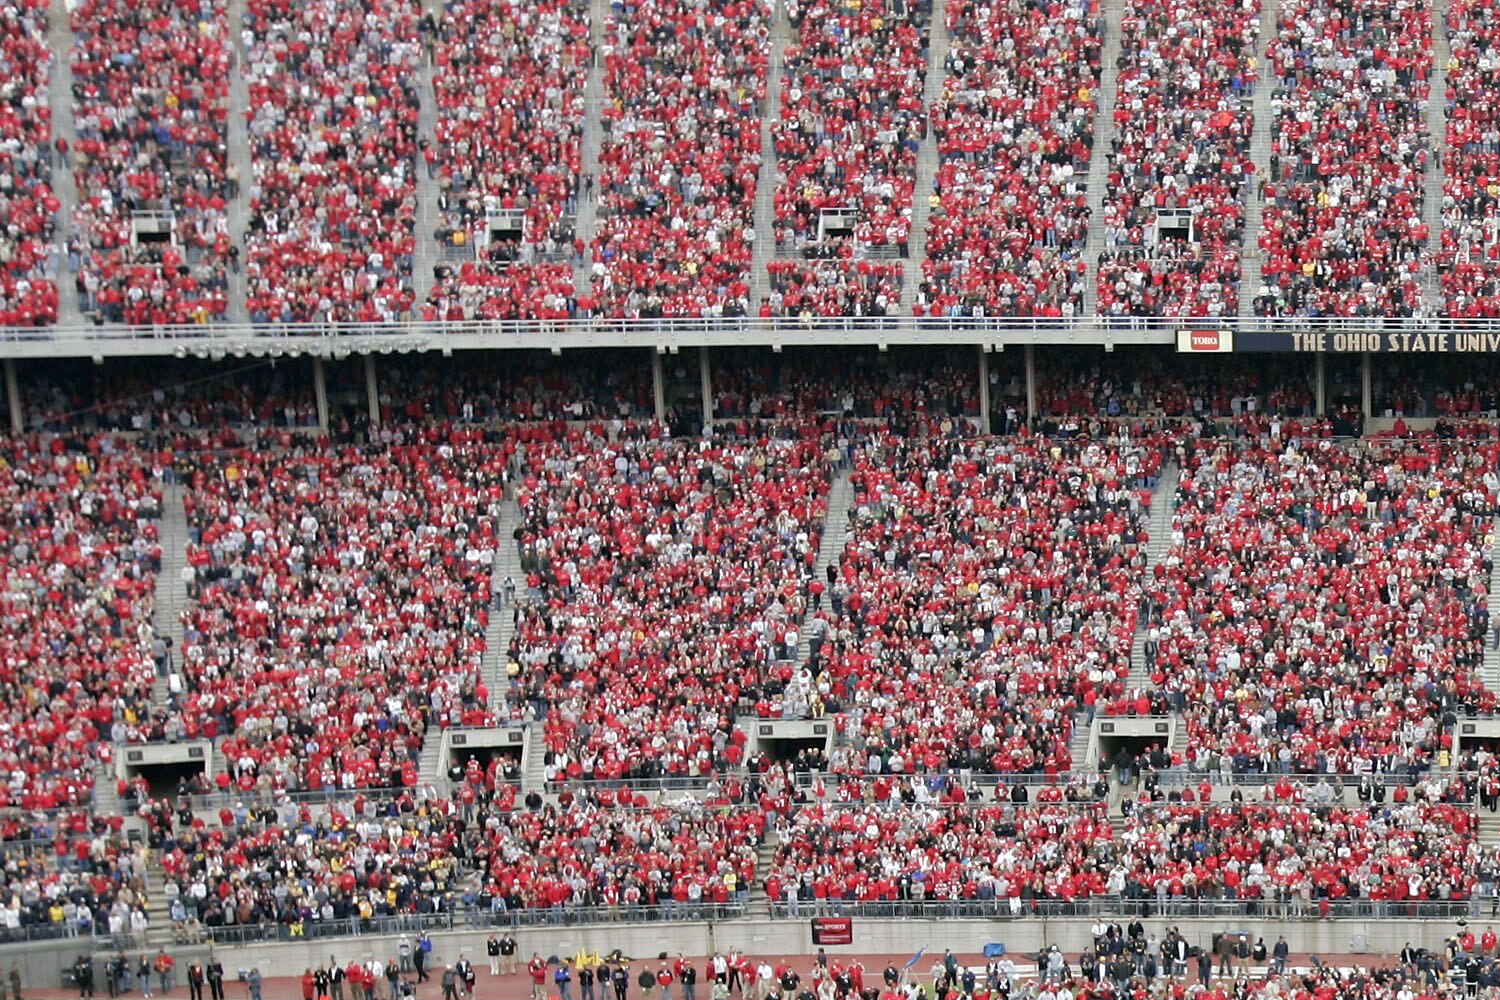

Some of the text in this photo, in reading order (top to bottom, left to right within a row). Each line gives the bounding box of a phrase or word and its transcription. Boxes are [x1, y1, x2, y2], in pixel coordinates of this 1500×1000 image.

[1191, 336, 1218, 346] TORO
[1292, 333, 1327, 352] THE
[1333, 333, 1381, 352] OHIO
[1387, 333, 1449, 352] STATE
